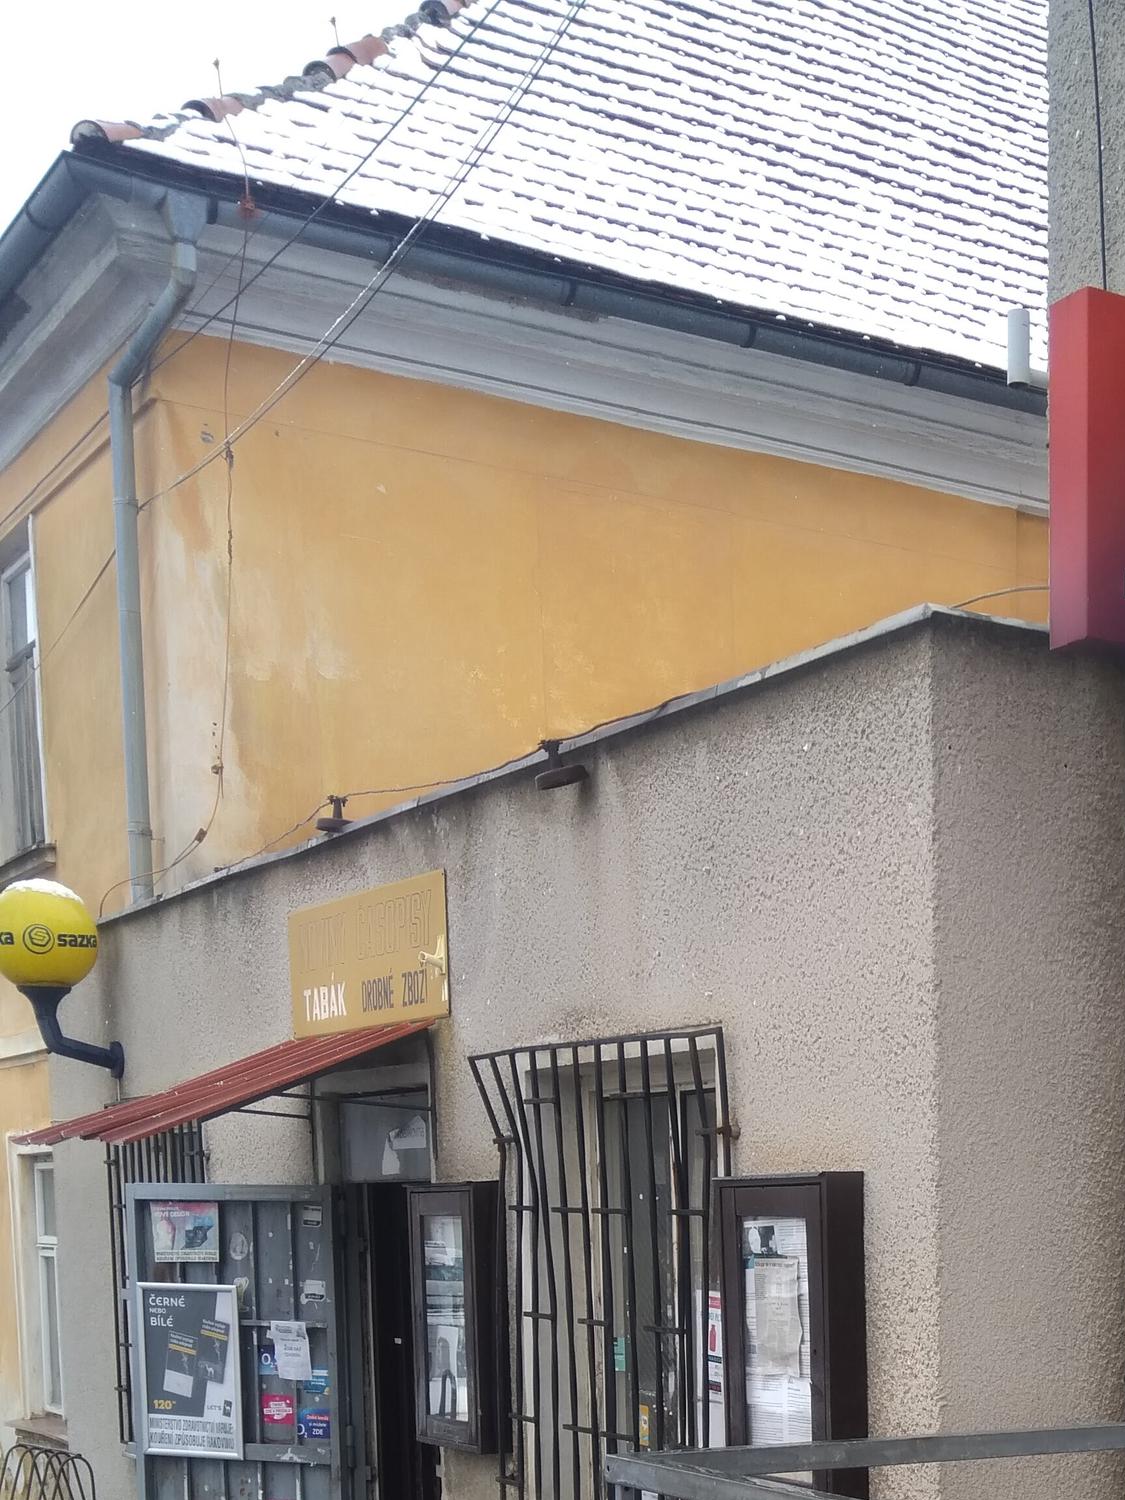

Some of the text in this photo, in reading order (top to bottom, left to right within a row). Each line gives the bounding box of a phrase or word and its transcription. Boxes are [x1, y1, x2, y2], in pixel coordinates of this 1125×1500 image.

[303, 961, 428, 1022] TABÁK DROBNÉ ZBOŽÍ
[149, 1294, 186, 1307] ČERNÉ
[150, 1314, 174, 1327] BÍLÉ
